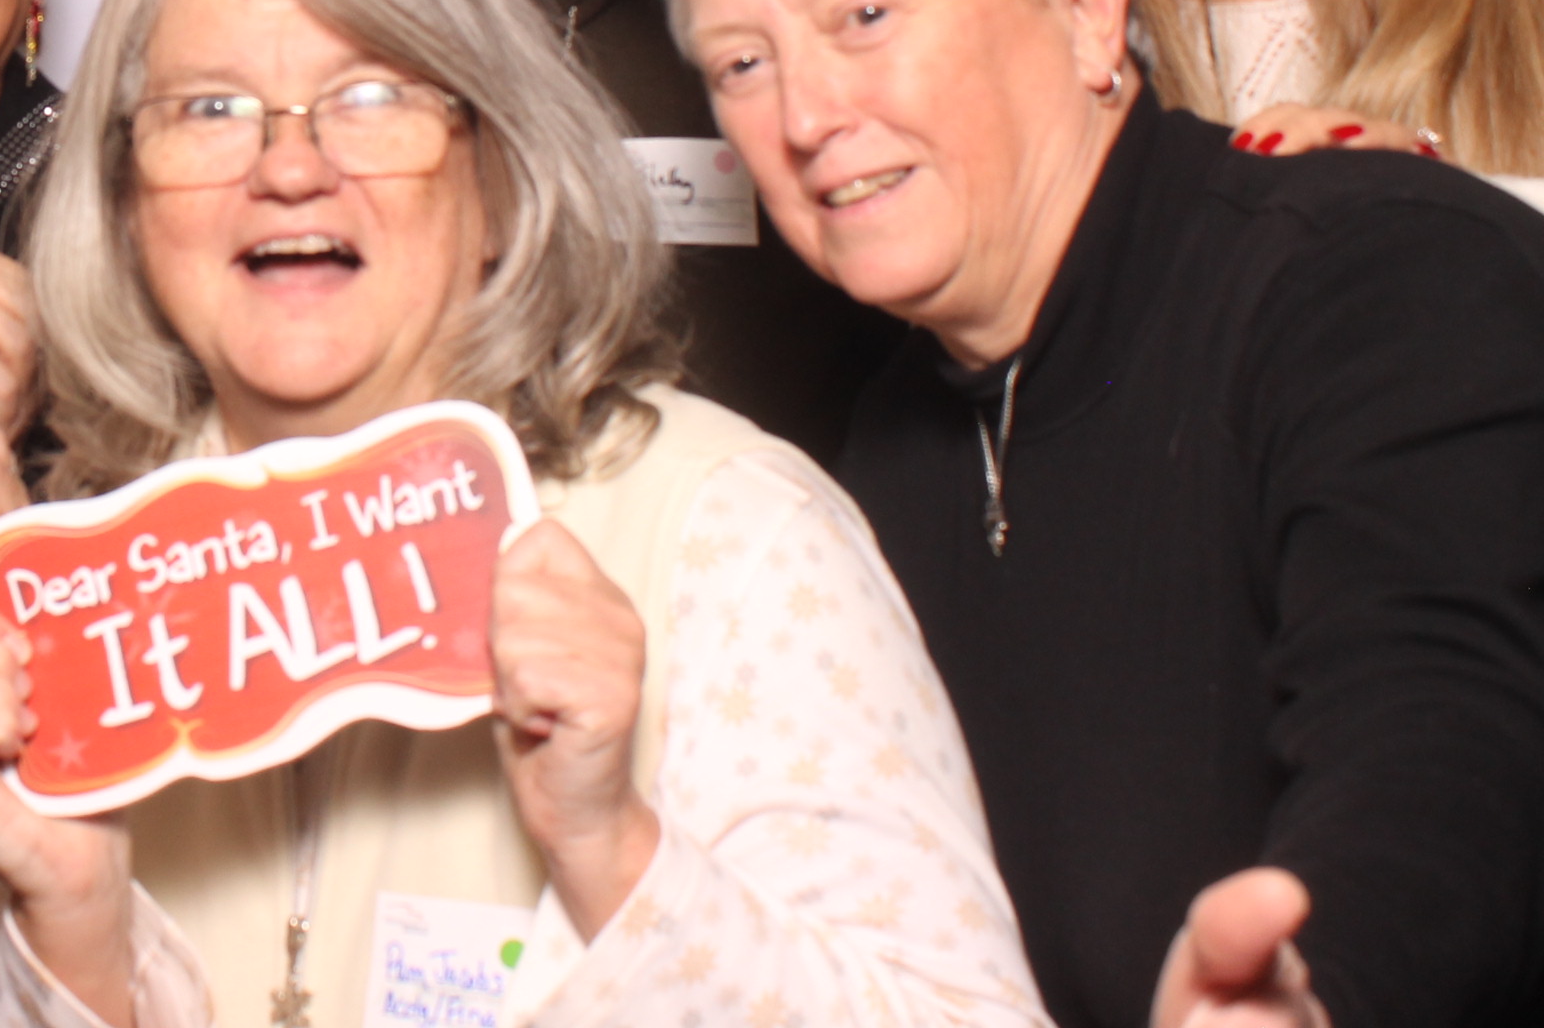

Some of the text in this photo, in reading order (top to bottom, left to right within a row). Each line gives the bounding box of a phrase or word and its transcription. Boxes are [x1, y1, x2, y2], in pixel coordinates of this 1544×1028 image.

[4, 459, 486, 624] Dear Santa, I Want
[82, 542, 438, 728] It ALL!
